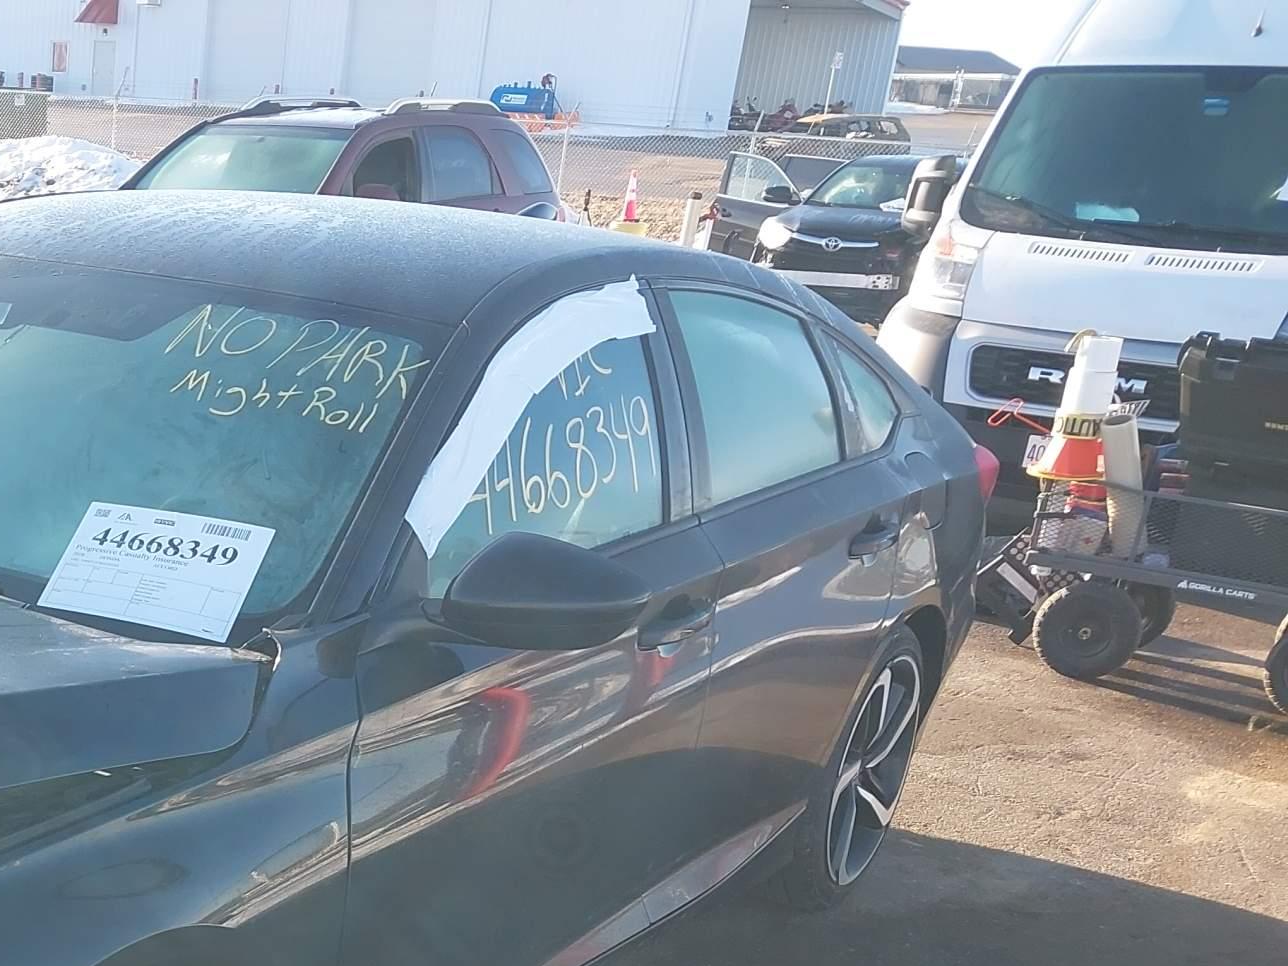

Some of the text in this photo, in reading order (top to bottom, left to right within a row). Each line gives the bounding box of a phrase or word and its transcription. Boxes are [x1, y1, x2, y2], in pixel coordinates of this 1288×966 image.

[165, 303, 430, 400] NO PARK
[1027, 366, 1148, 394] RM
[170, 369, 378, 432] Might Roll
[75, 544, 118, 557] Progressive
[118, 549, 150, 560] Casualty
[152, 554, 190, 567] Insurance
[92, 527, 239, 566] 44668349
[1189, 582, 1257, 600] GORILLA CARTS
